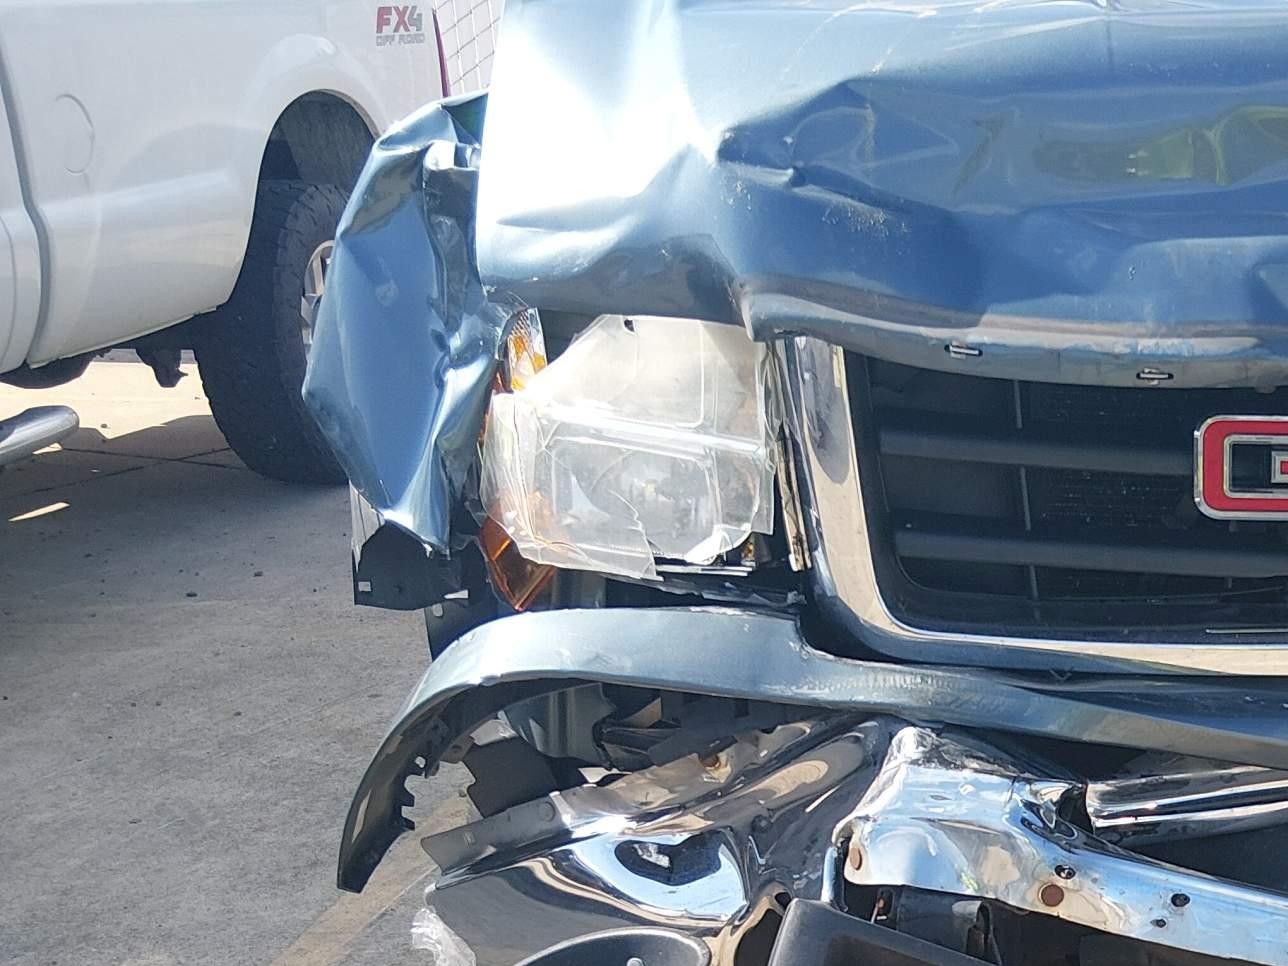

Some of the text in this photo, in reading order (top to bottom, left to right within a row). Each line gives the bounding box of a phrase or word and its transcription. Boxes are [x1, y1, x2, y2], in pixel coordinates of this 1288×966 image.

[376, 5, 423, 34] FX4
[375, 33, 425, 47] OFF ROAD
